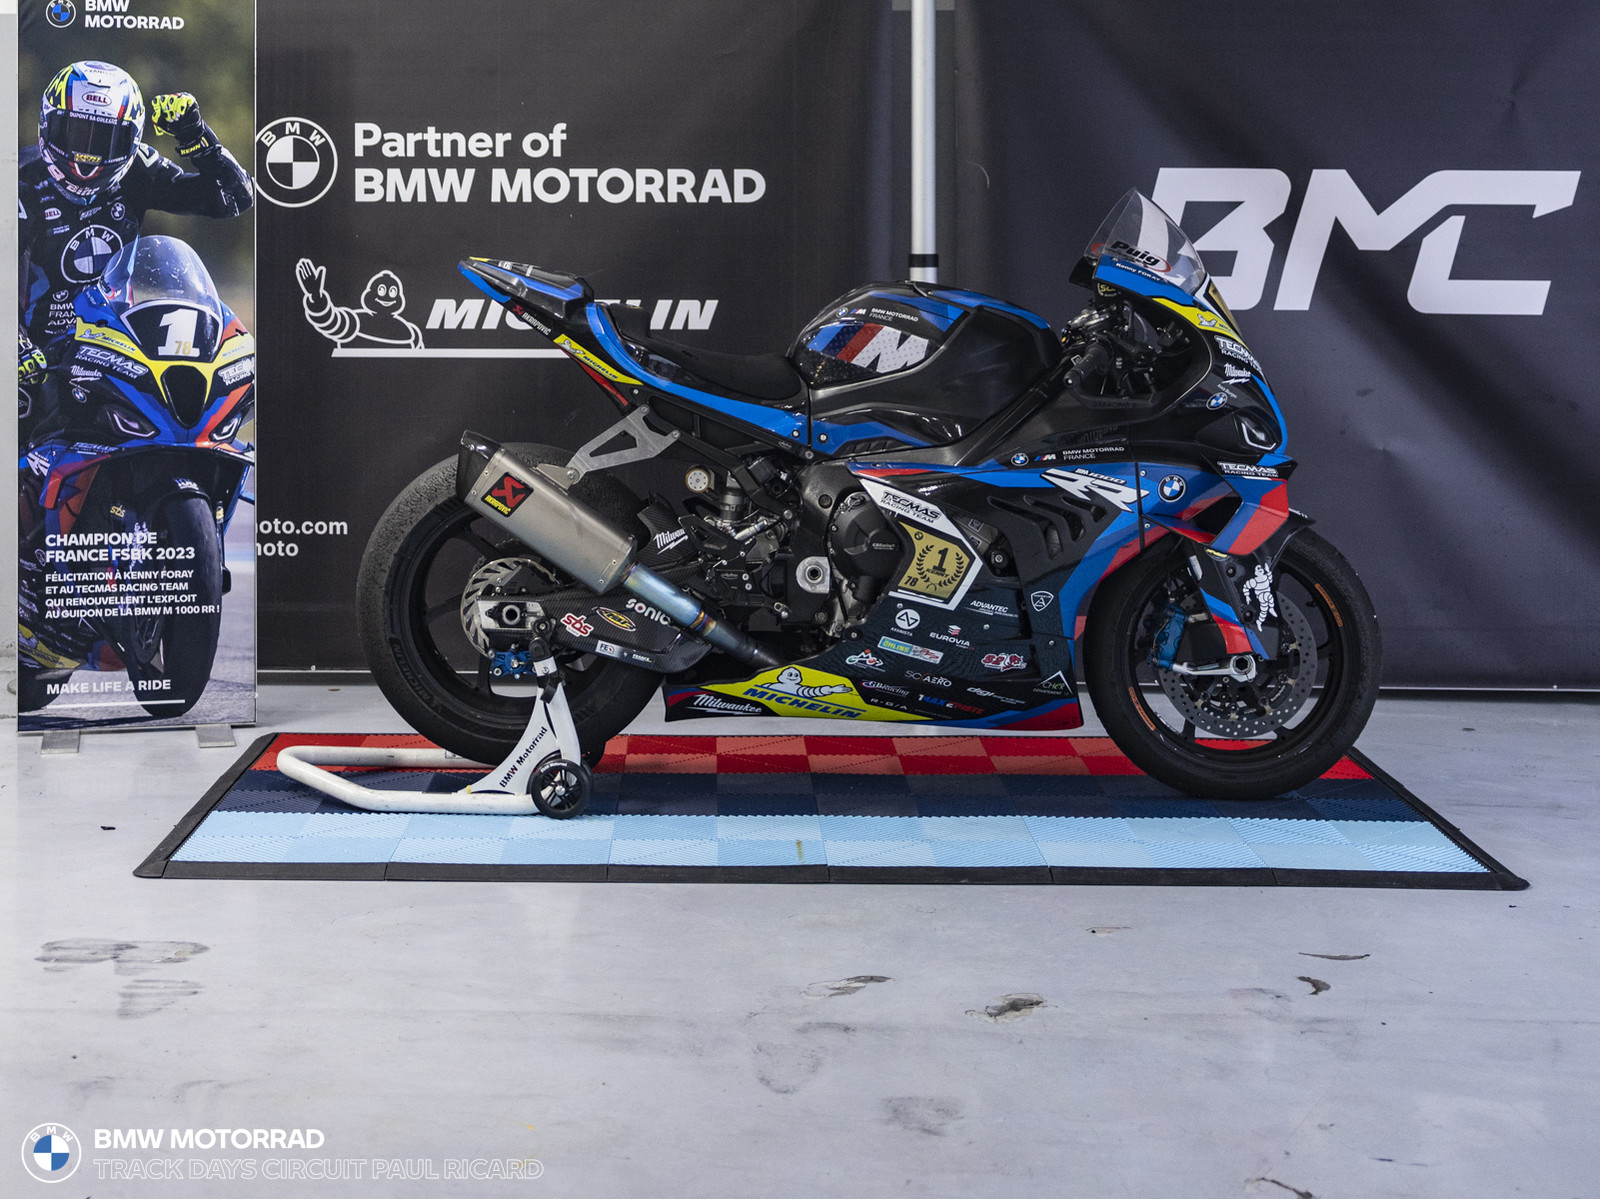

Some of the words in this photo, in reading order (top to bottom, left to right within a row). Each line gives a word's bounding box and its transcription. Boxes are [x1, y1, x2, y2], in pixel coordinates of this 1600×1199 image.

[84, 15, 185, 30] MOTORRAD
[86, 94, 108, 104] BELL
[69, 111, 89, 120] DUPONT
[354, 122, 512, 158] Partner
[522, 121, 567, 158] of
[354, 167, 475, 203] BMW
[490, 166, 766, 204] MOTORRAD
[1137, 167, 1581, 315] BMC
[1110, 240, 1160, 266] Puig
[1115, 263, 1136, 273] Kenny
[426, 299, 719, 331] MICIN
[869, 313, 893, 322] FRANCE
[886, 310, 919, 322] MOTORRAD
[157, 308, 200, 357] 1
[102, 336, 136, 352] MICHELIN
[175, 341, 192, 355] 78
[78, 345, 149, 376] TECMAS
[583, 356, 619, 380] MICHELIN
[111, 365, 138, 380] TEAM
[1063, 453, 1096, 461] FRANCE
[1082, 446, 1125, 454] MOTORRAD
[1217, 462, 1278, 474] TECMAS
[880, 499, 910, 515] RACING
[911, 511, 934, 524] TEAM
[883, 491, 942, 520] TECMAS
[256, 518, 348, 535] oto.com
[45, 532, 133, 547] CHAMPION
[135, 532, 158, 544] DE
[45, 549, 109, 563] FRANCE
[112, 548, 152, 562] FSBK
[156, 547, 196, 560] 2023
[932, 547, 949, 573] 1
[45, 571, 113, 582] FÉLICITATION
[114, 570, 123, 580] À
[123, 571, 159, 580] KENNY
[160, 569, 195, 579] FORAY
[904, 576, 919, 587] 78
[45, 586, 58, 595] ET
[59, 585, 74, 594] AU
[75, 584, 118, 593] TECMAS
[119, 583, 158, 592] RACING
[159, 582, 189, 591] TEAM
[45, 598, 65, 608] QUI
[66, 596, 146, 607] RENOUVELLENT
[147, 594, 198, 604] L'EXPLOIT
[970, 600, 1008, 613] ADVANTEC
[45, 610, 60, 619] AU
[61, 609, 103, 618] GUIDON
[104, 608, 119, 617] DE
[119, 608, 133, 616] LA
[134, 607, 161, 616] BMW
[162, 606, 173, 615] M
[174, 606, 200, 615] 1000
[201, 605, 215, 614] RR
[562, 613, 594, 637] sbs
[929, 632, 971, 647] EUROVIA
[46, 682, 89, 695] MAKE
[92, 681, 122, 693] LIFE
[125, 681, 135, 691] A
[138, 679, 172, 691] RIDE
[694, 693, 763, 714] Milwaukee
[742, 687, 862, 719] MICHELIN
[499, 764, 519, 789] BMW
[516, 726, 548, 767] Motorrad
